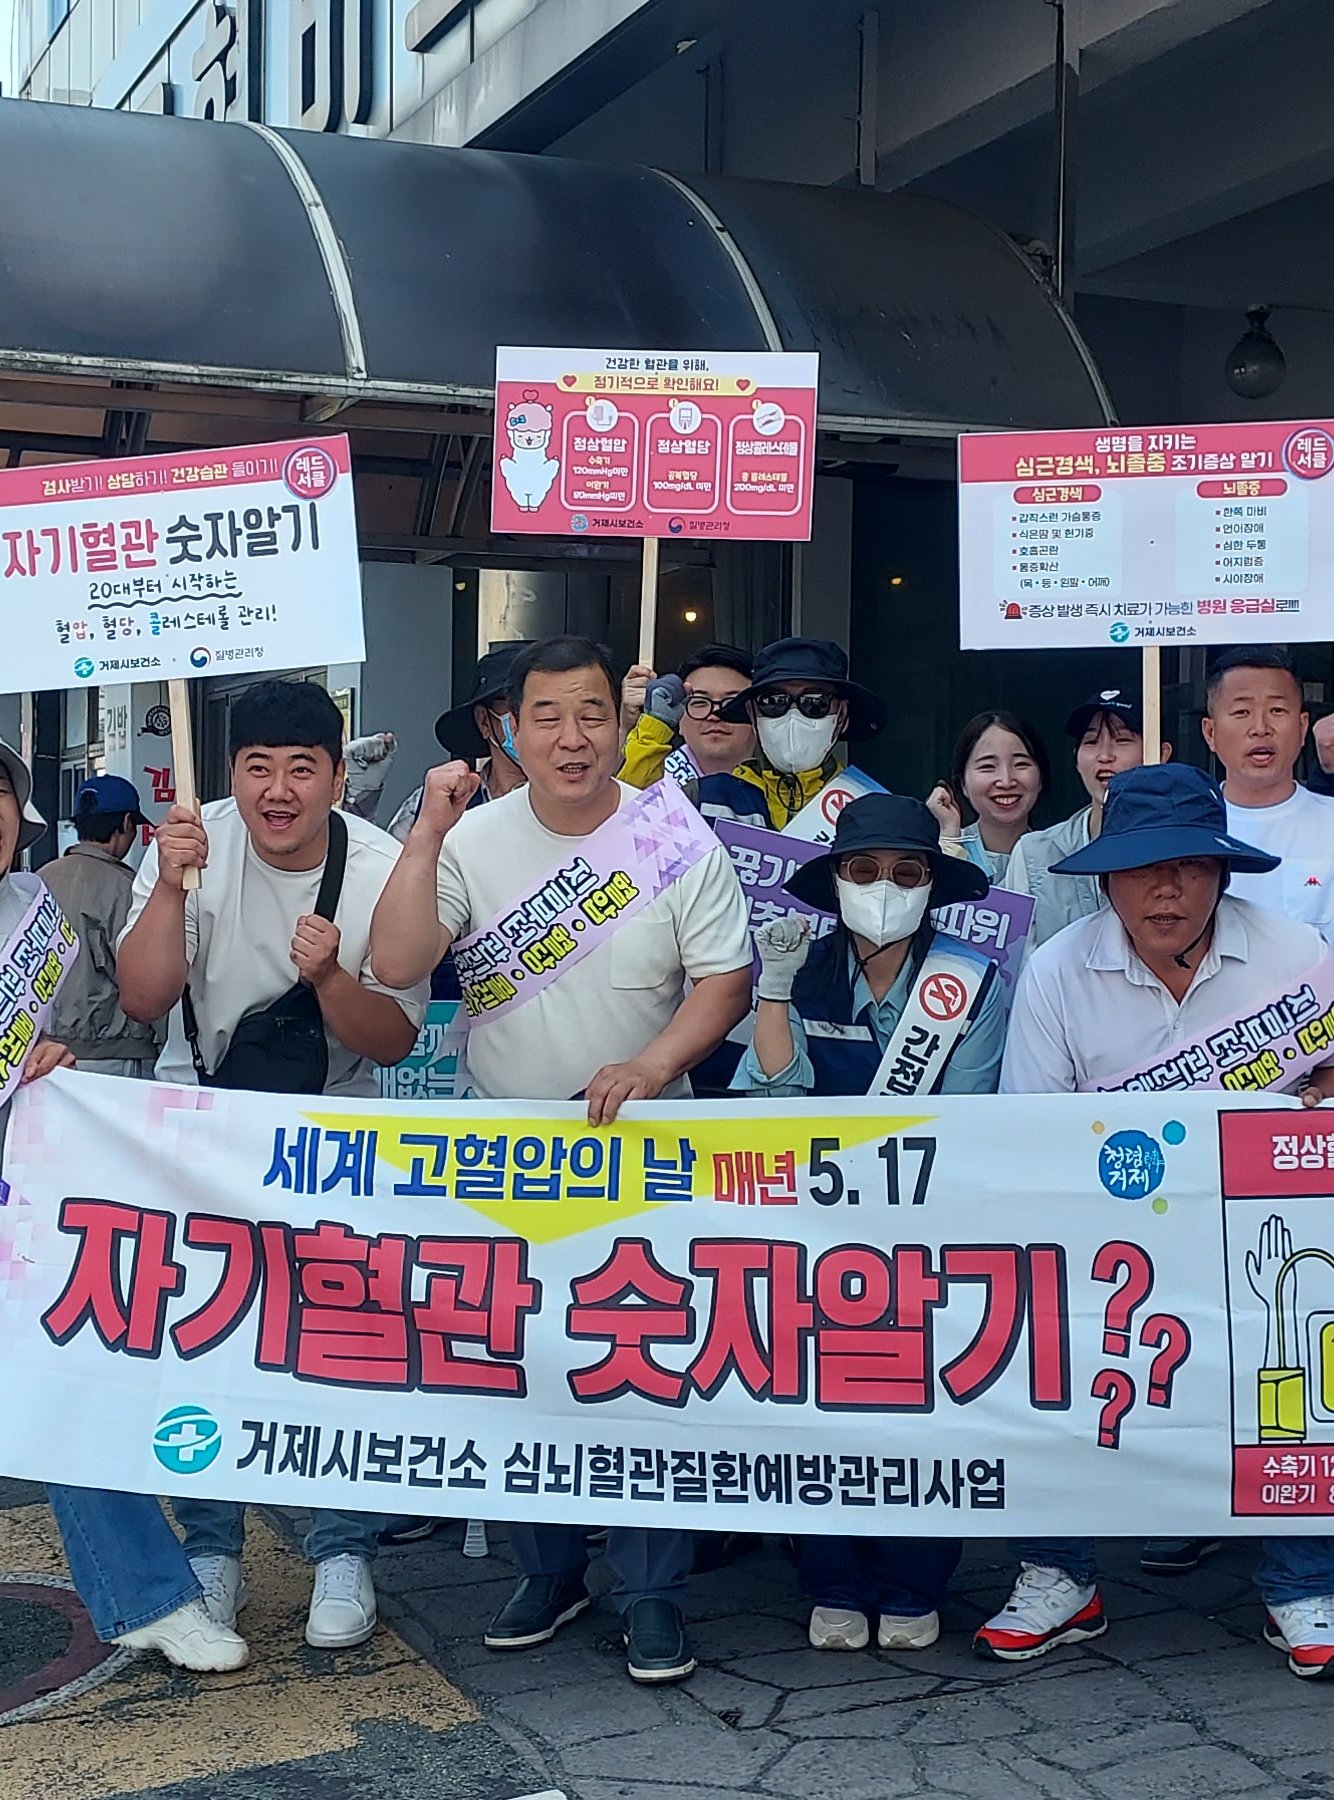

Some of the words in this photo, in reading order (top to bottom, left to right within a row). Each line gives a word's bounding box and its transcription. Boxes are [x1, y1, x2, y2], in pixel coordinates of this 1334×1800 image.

[605, 358, 641, 370] 건강한
[594, 376, 659, 390] 정기적으로
[663, 377, 719, 391] 확인해요!
[574, 437, 627, 452] 정상혈압
[658, 440, 711, 454] 정상혈당
[1095, 435, 1144, 452] 생명을
[1147, 434, 1196, 451] 지키는
[1296, 437, 1328, 453] 레드
[296, 455, 326, 473] 레드
[1015, 456, 1101, 477] 심근경색,
[1106, 452, 1166, 474] 뇌졸중
[1171, 453, 1235, 473] 조기증상
[1240, 451, 1273, 469] 알기
[1296, 451, 1327, 468] 서클
[41, 473, 105, 496] 검사받기!
[107, 469, 167, 491] 상담하기!
[171, 463, 228, 484] 건강습관
[231, 457, 279, 478] 들이기!
[296, 471, 327, 489] 서클
[1032, 486, 1083, 502] 심근경색
[1223, 481, 1261, 496] 뇌졸중
[1019, 512, 1059, 523] 갑작스런
[1061, 511, 1101, 522] 가슴통증
[1223, 506, 1244, 519] 한쪽
[1246, 505, 1267, 518] 마비
[592, 519, 643, 528] 거제시보건소
[1223, 522, 1264, 535] 언어장애
[2, 518, 159, 579] 자기혈관
[166, 502, 320, 566] 숫자알기
[1019, 529, 1049, 539] 식은땀
[1019, 546, 1059, 556] 호흡곤란
[1223, 539, 1244, 552] 심한
[1246, 538, 1267, 551] 두통
[1020, 562, 1059, 572] 통증확산
[1223, 555, 1264, 568] 어지럼증
[88, 577, 162, 600] 20대부터
[171, 569, 238, 593] 시작하는
[1223, 572, 1264, 585] 시야장애
[1028, 605, 1055, 618] 증상
[1057, 604, 1083, 618] 발생
[1085, 604, 1111, 617] 즉시
[1114, 603, 1153, 617] 치료가
[1155, 602, 1193, 616] 가능한
[1197, 599, 1227, 615] 병원
[55, 619, 96, 644] 혈압,
[102, 615, 142, 639] 혈당,
[148, 605, 230, 635] 콜레스테롤
[237, 604, 278, 629] 관리!
[1134, 626, 1197, 637] 거제시보건소
[214, 645, 265, 662] 질병관리청
[98, 655, 162, 672] 거제시보건소
[498, 856, 599, 948] 지금부터
[581, 870, 640, 927] 혈압
[519, 924, 578, 974] 혈당
[1207, 983, 1321, 1068] 지금부터
[879, 1025, 940, 1096] 간접
[1220, 1049, 1284, 1091] 혈당
[263, 1126, 380, 1198] 세계
[392, 1131, 622, 1201] 고혈압의
[643, 1136, 698, 1203] 날
[712, 1149, 797, 1208] 매년
[808, 1136, 861, 1206] 5.
[877, 1136, 939, 1206] 17
[1107, 1167, 1150, 1193] 거제
[39, 1196, 544, 1400] 자기혈관
[566, 1236, 1073, 1413] 숫자알기
[235, 1418, 489, 1491] 거제시보건소
[502, 1440, 1007, 1510] 심뇌혈관질환예방관리사업
[1262, 1453, 1318, 1480] 수축기
[1261, 1482, 1317, 1507] 이완기
